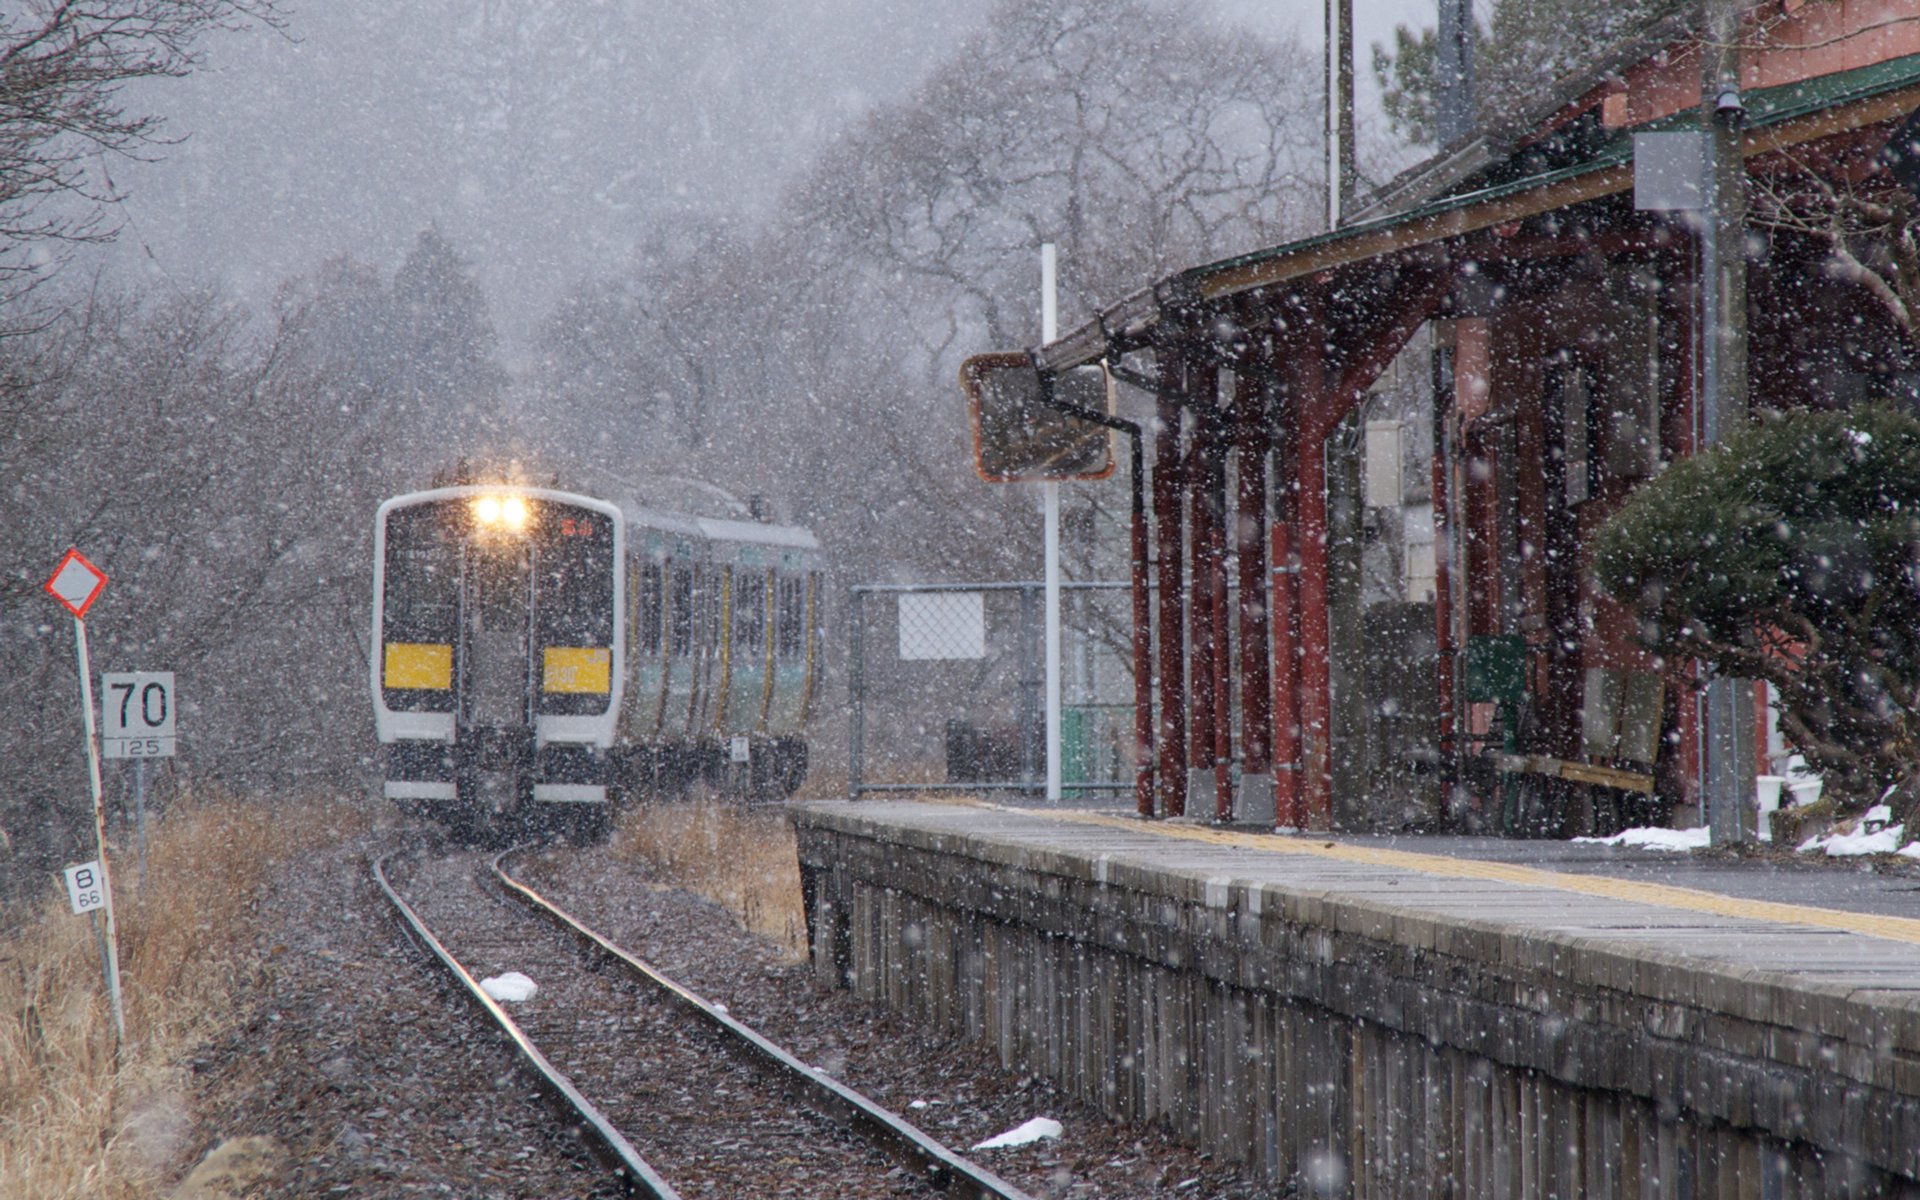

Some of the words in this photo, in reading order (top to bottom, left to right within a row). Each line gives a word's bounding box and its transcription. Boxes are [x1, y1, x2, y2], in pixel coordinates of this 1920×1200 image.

[111, 682, 167, 728] 70
[121, 740, 160, 755] 125
[76, 868, 94, 889] 8
[79, 890, 100, 907] 66
